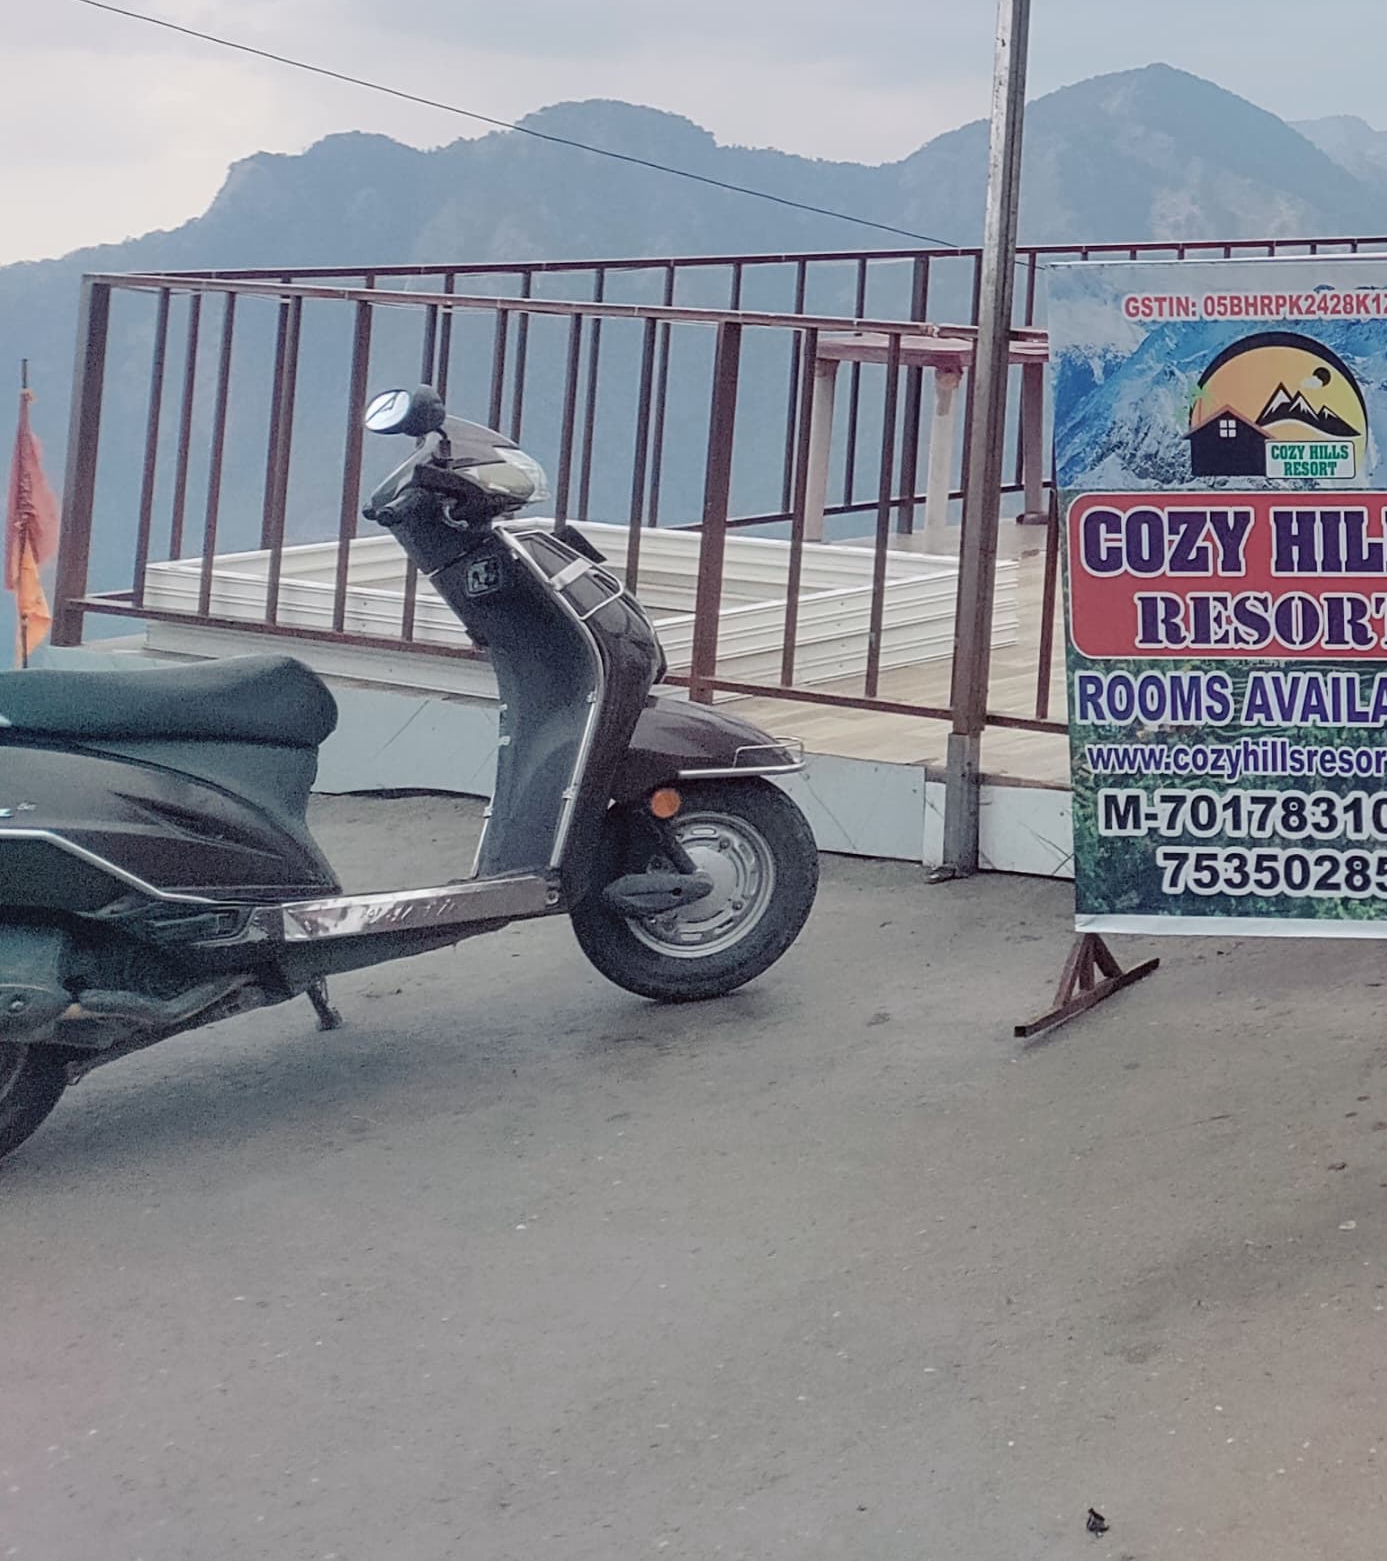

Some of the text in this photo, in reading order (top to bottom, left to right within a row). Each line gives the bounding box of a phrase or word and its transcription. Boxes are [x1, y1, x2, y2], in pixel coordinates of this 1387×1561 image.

[1125, 297, 1197, 318] GSTIN:
[1271, 444, 1349, 460] COZY HILLS
[1284, 462, 1337, 476] RESORT
[1083, 511, 1251, 573] COZY
[1078, 676, 1229, 721] ROOMS
